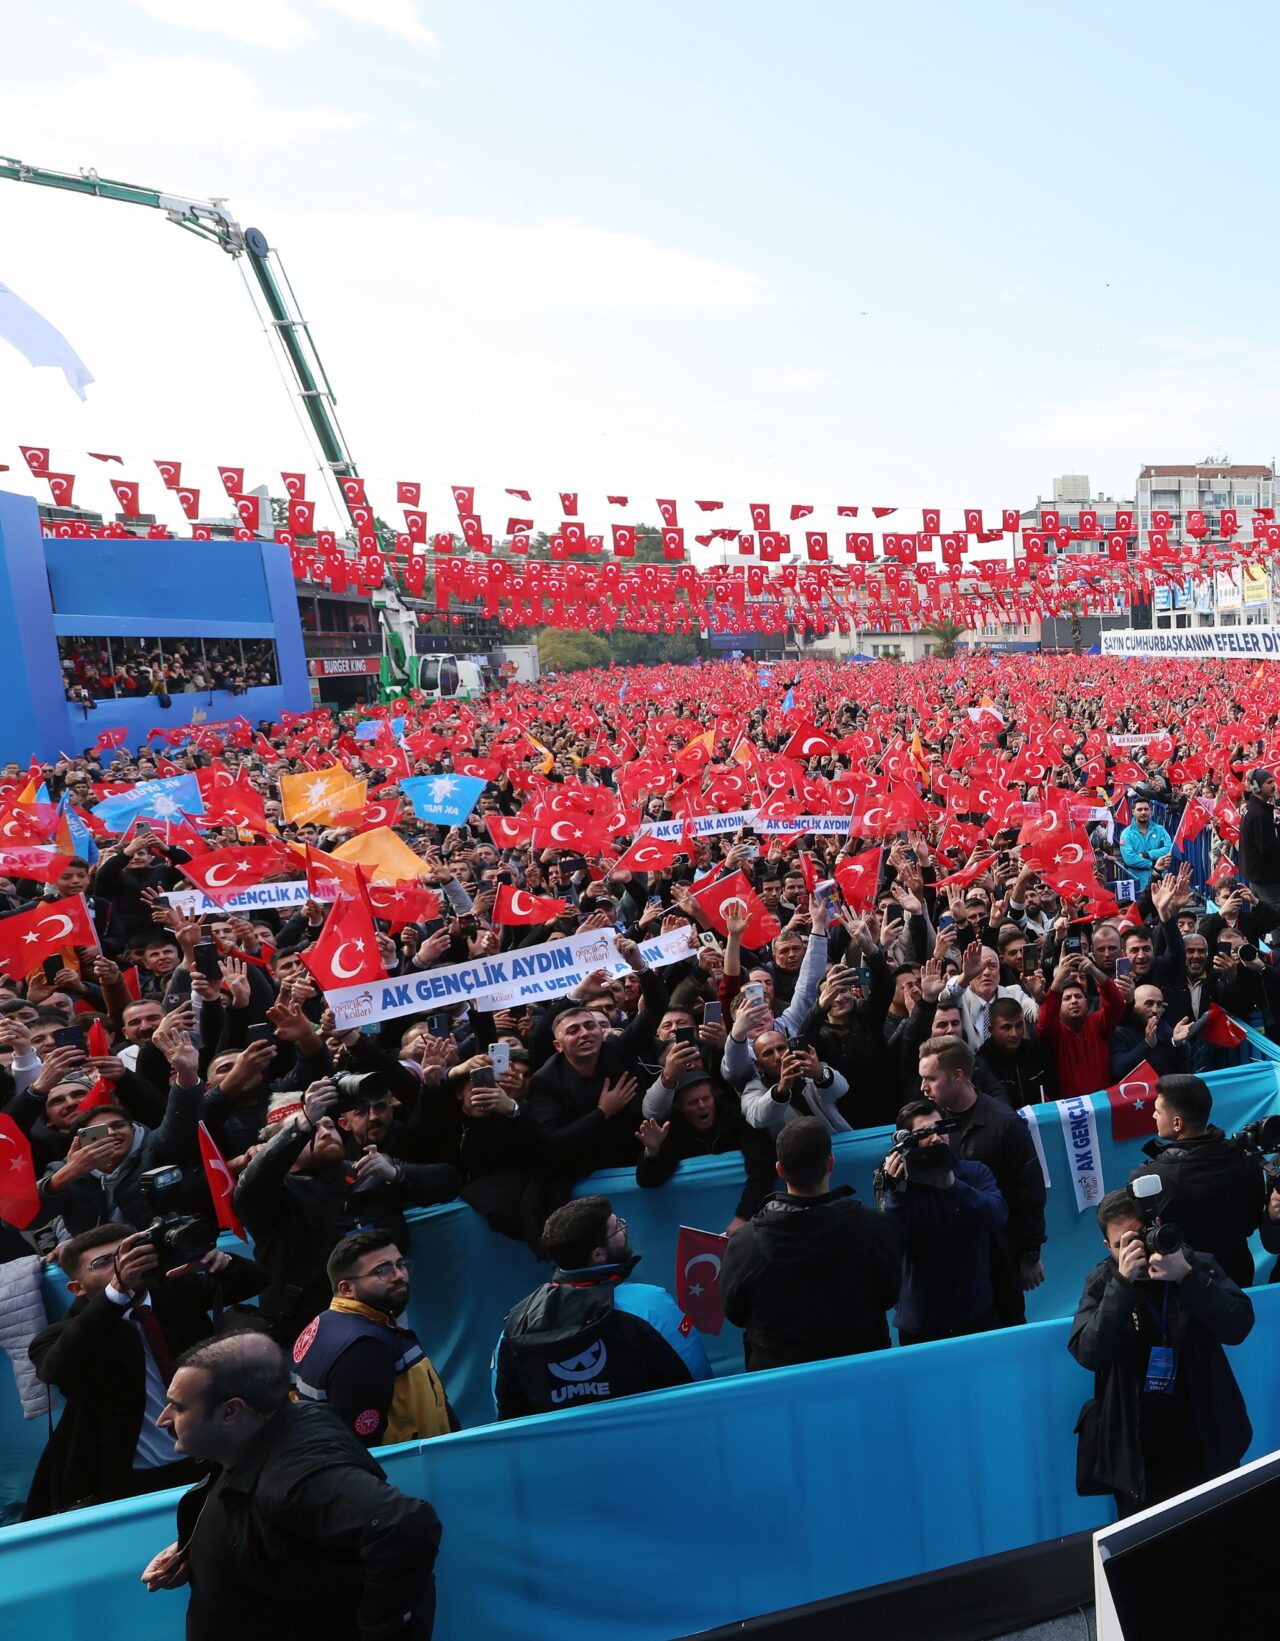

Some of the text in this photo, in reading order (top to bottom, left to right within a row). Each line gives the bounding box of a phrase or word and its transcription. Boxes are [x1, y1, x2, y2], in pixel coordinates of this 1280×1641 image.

[1104, 636, 1124, 651] SAYIN
[1125, 634, 1215, 655] CUMHURBAŞKANIM
[1217, 632, 1261, 652] EFELER
[324, 659, 367, 674] BURGER KING
[656, 825, 671, 837] AK
[716, 815, 745, 829] AYDIN
[767, 819, 780, 830] AK
[825, 819, 850, 831] AYDIN
[201, 893, 226, 909] AK
[228, 885, 292, 906] GENÇLİK
[381, 946, 574, 1010] AK GENÇLİK AYDIN
[1074, 1149, 1094, 1171] AK
[551, 1382, 610, 1403] UMKE
